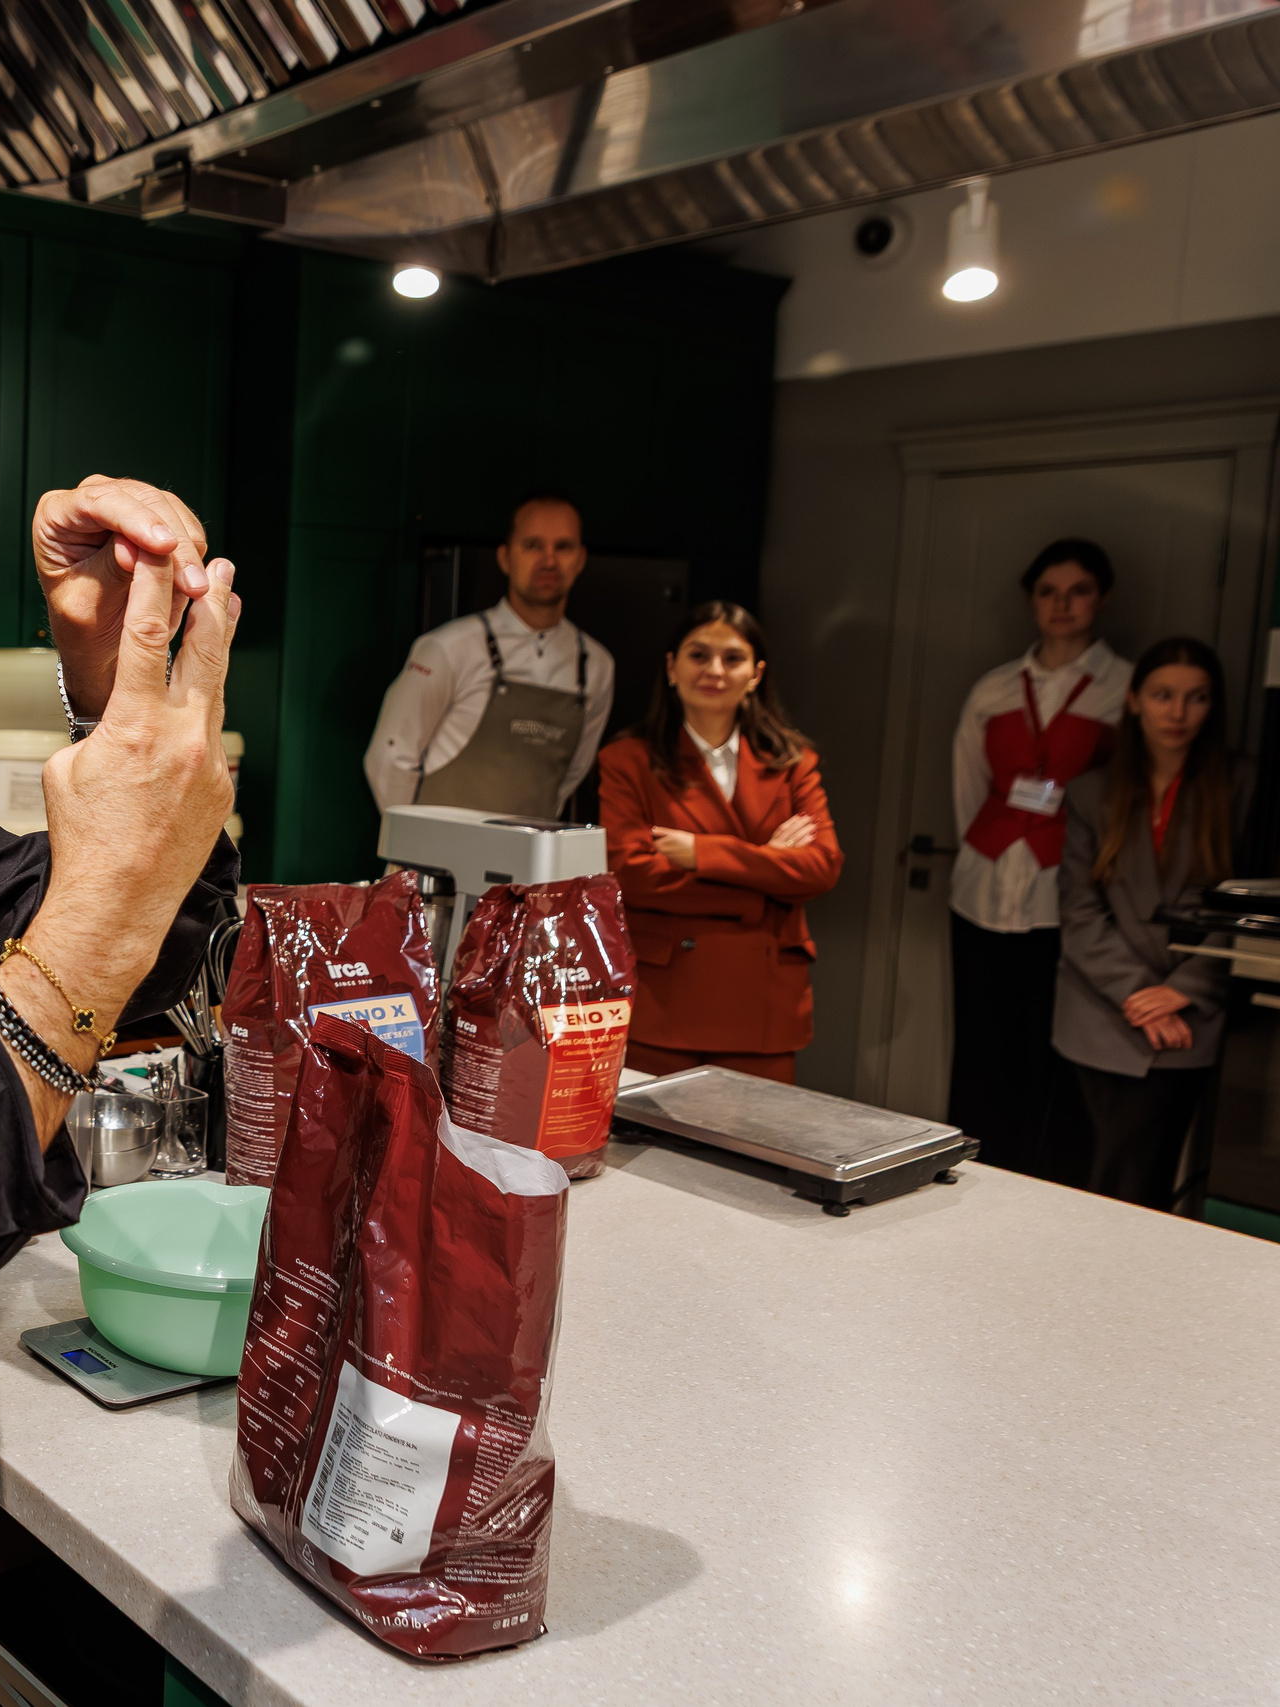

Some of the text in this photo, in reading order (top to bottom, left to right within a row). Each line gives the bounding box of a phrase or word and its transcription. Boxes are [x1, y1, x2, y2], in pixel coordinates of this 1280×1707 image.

[325, 960, 370, 980] irca
[391, 1004, 407, 1018] X
[608, 1008, 623, 1021] X
[231, 1022, 249, 1038] irca
[456, 1016, 478, 1035] irca
[444, 1567, 459, 1575] IRCA
[362, 1611, 374, 1625] kg
[381, 1615, 409, 1628] 11.00
[411, 1616, 422, 1629] lb
